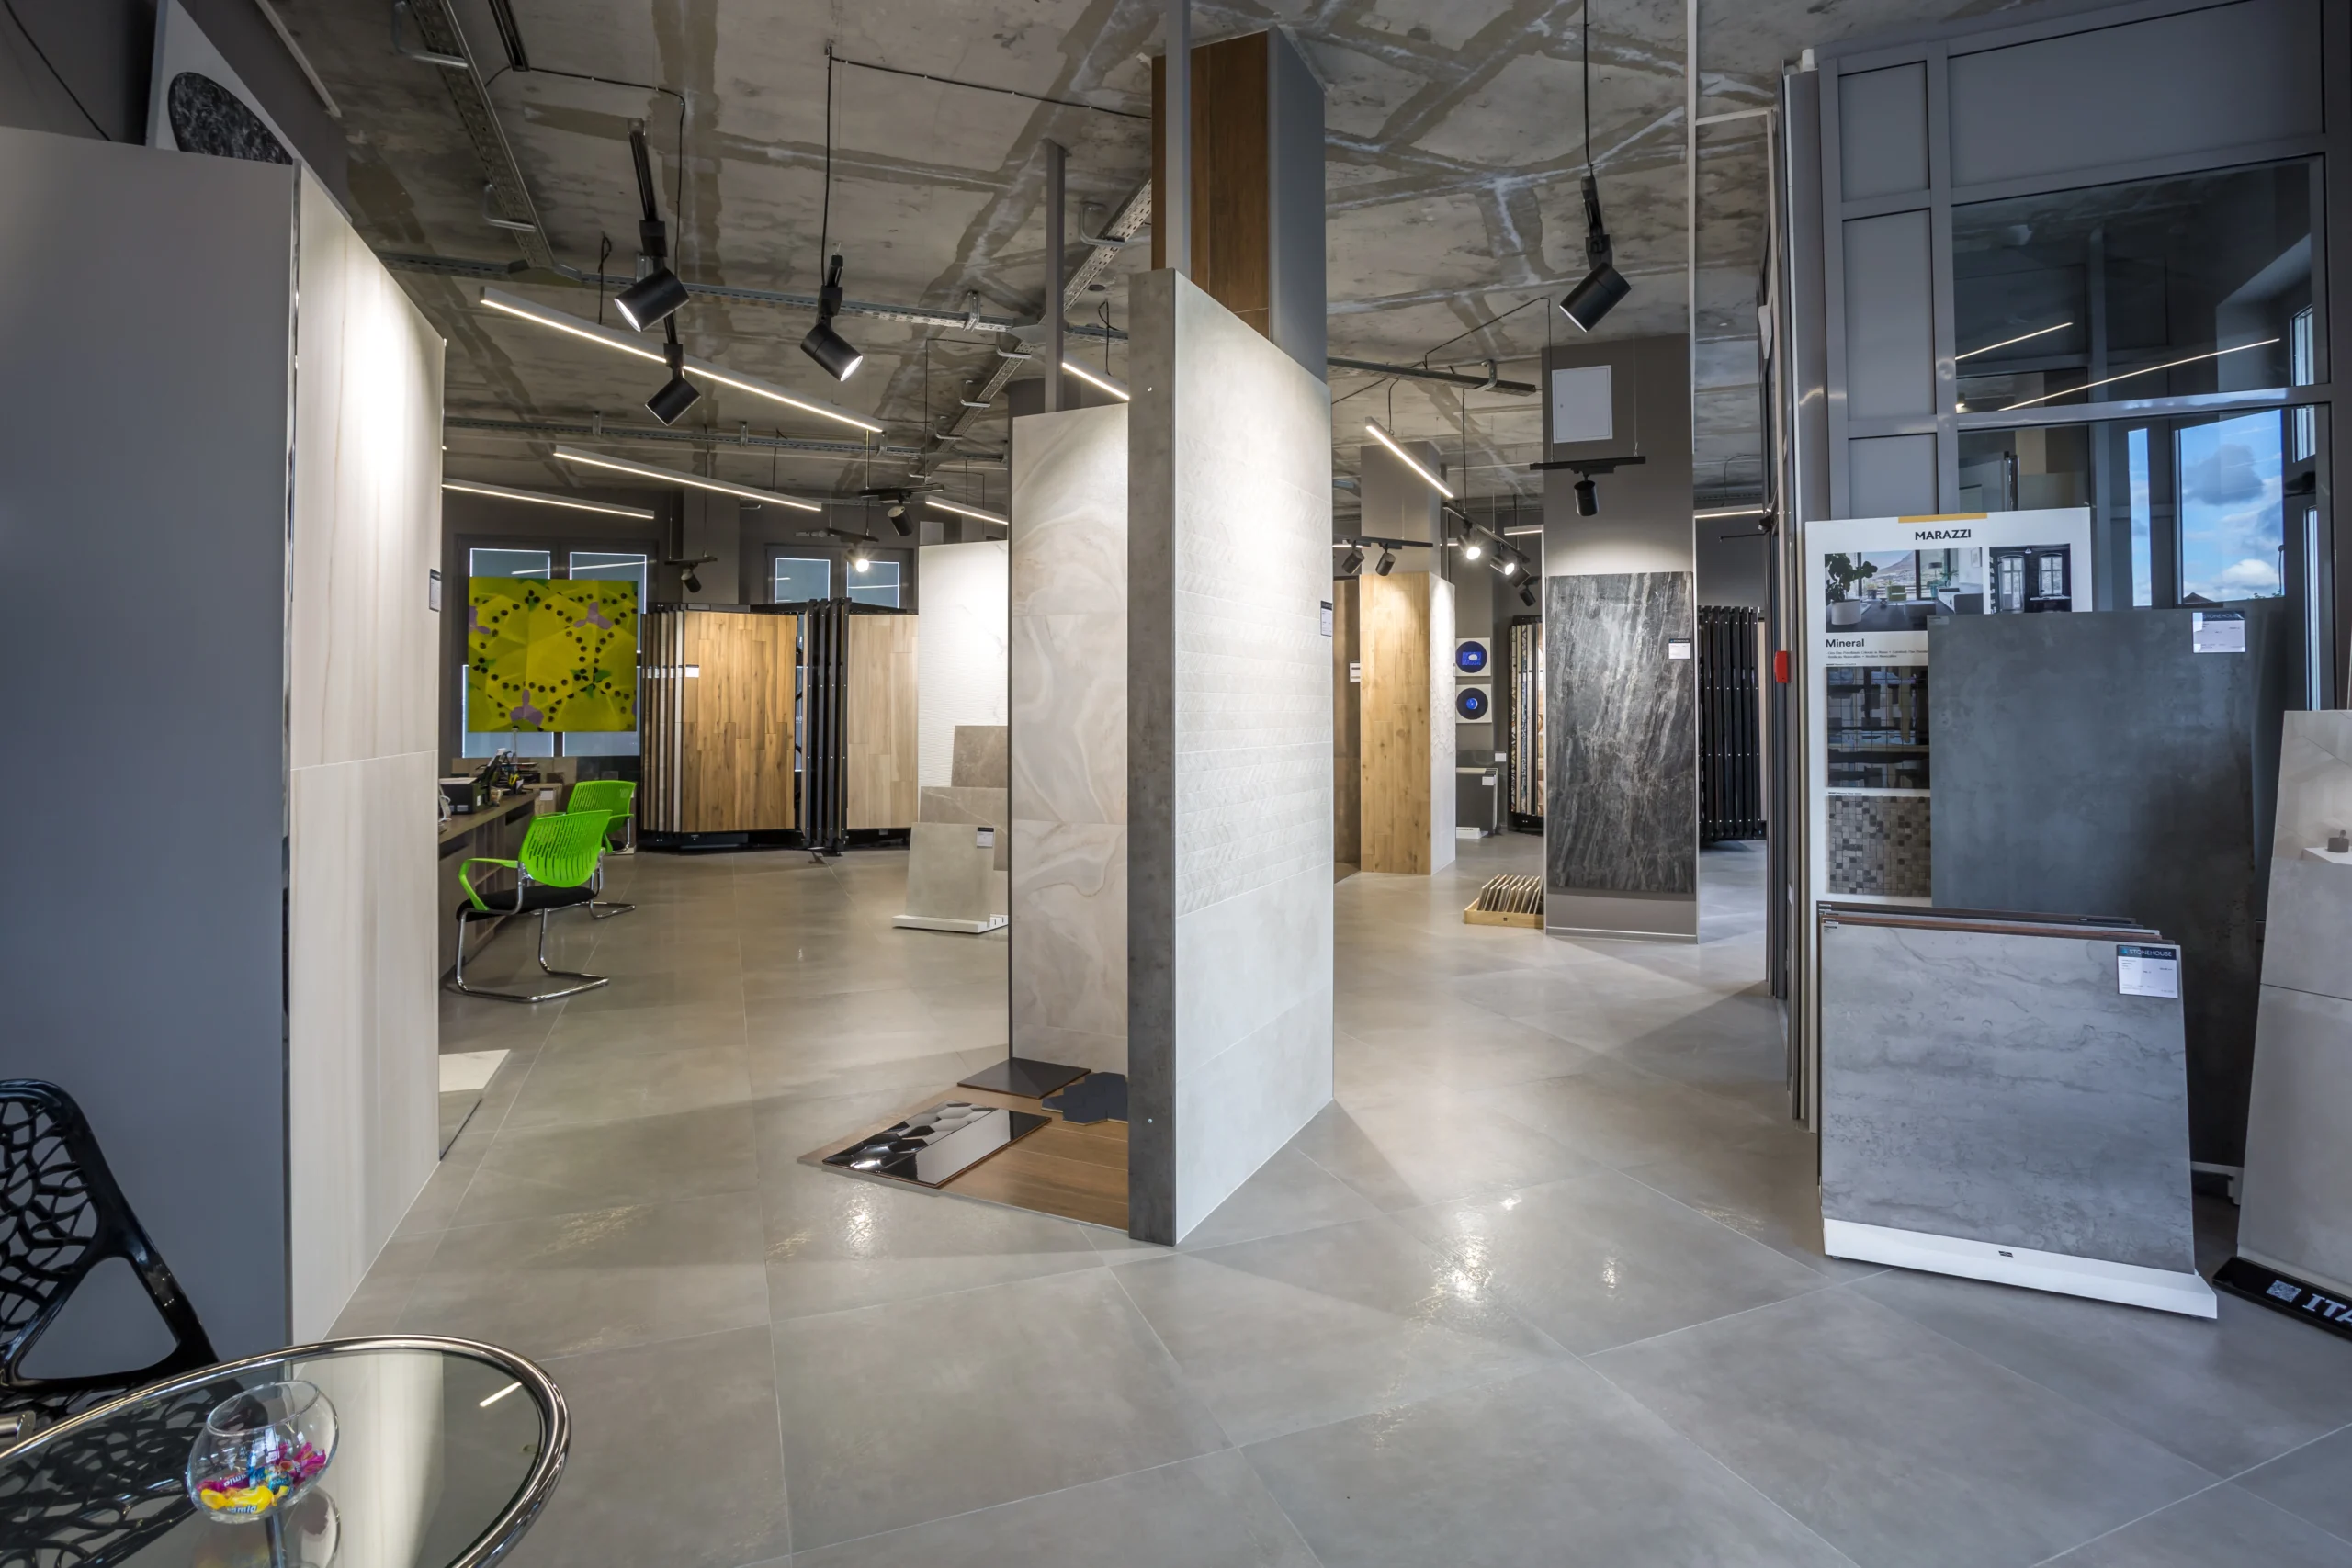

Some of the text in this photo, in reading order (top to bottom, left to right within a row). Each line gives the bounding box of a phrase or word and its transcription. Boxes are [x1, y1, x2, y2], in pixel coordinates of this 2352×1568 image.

[1915, 528, 1972, 540] MARAZZI
[1826, 638, 1865, 648] Mineral
[2129, 948, 2173, 957] STONEHOUSE
